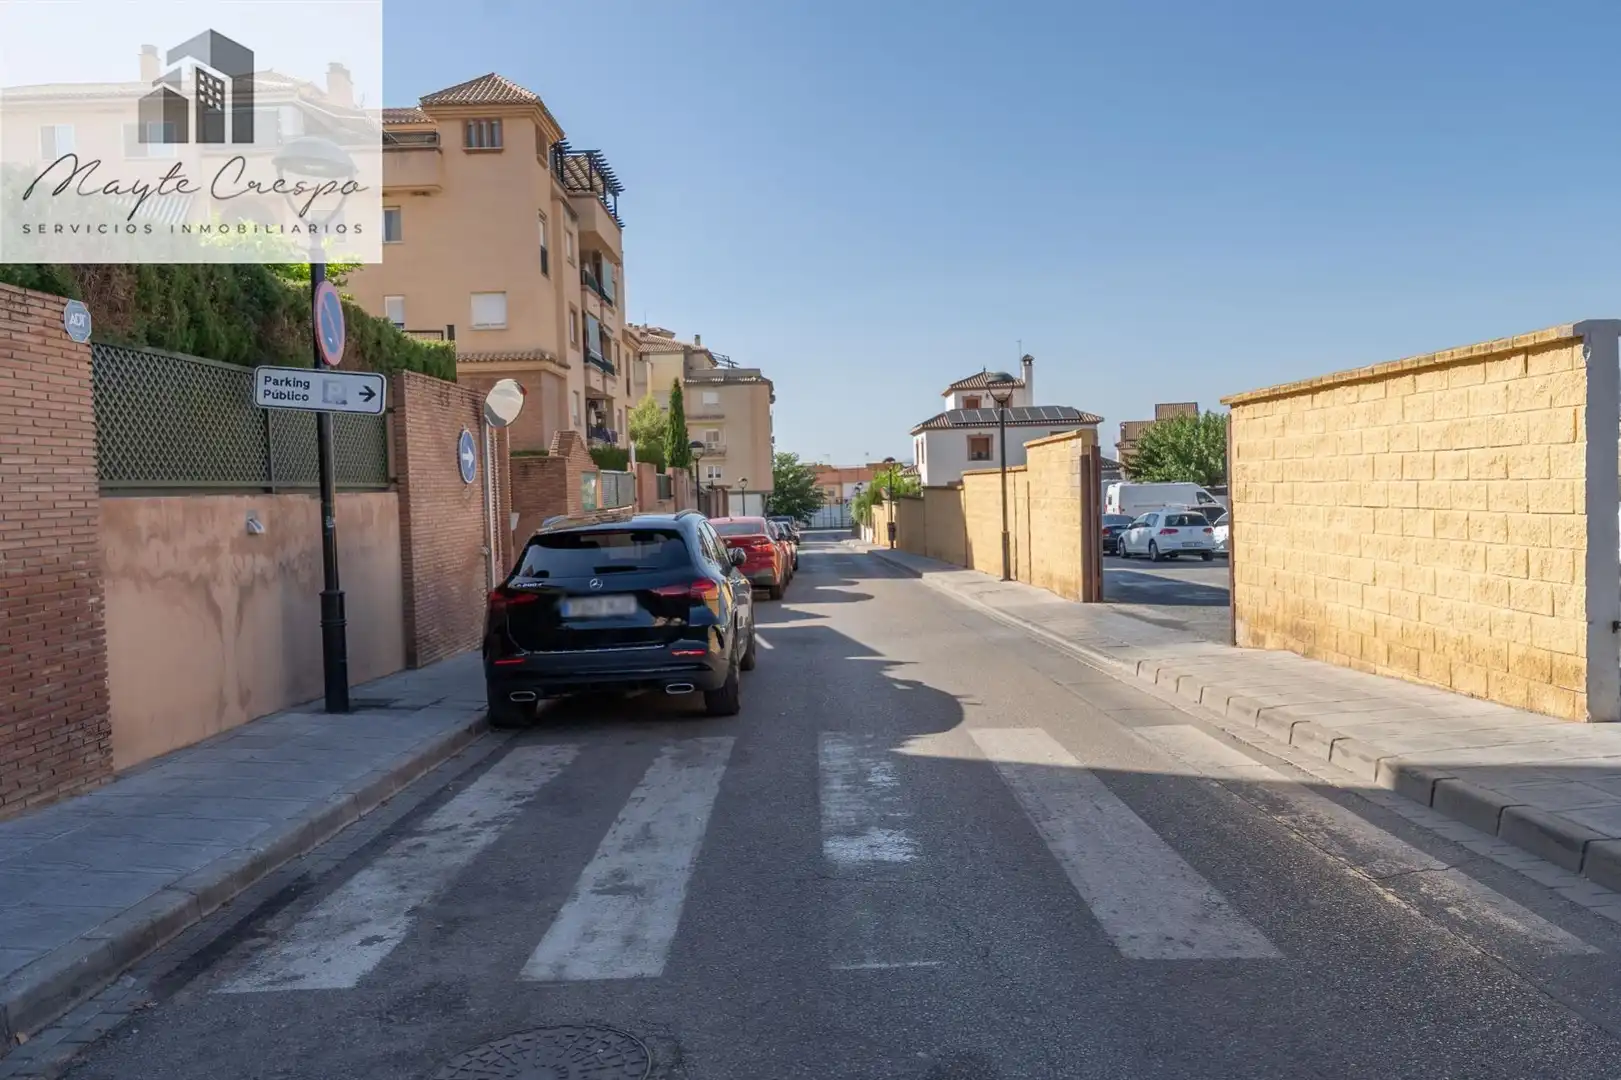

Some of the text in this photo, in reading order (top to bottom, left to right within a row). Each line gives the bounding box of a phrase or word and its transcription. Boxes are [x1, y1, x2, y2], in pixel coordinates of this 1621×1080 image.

[69, 313, 86, 327] ADT
[264, 376, 310, 390] Parking
[263, 389, 309, 401] Público
